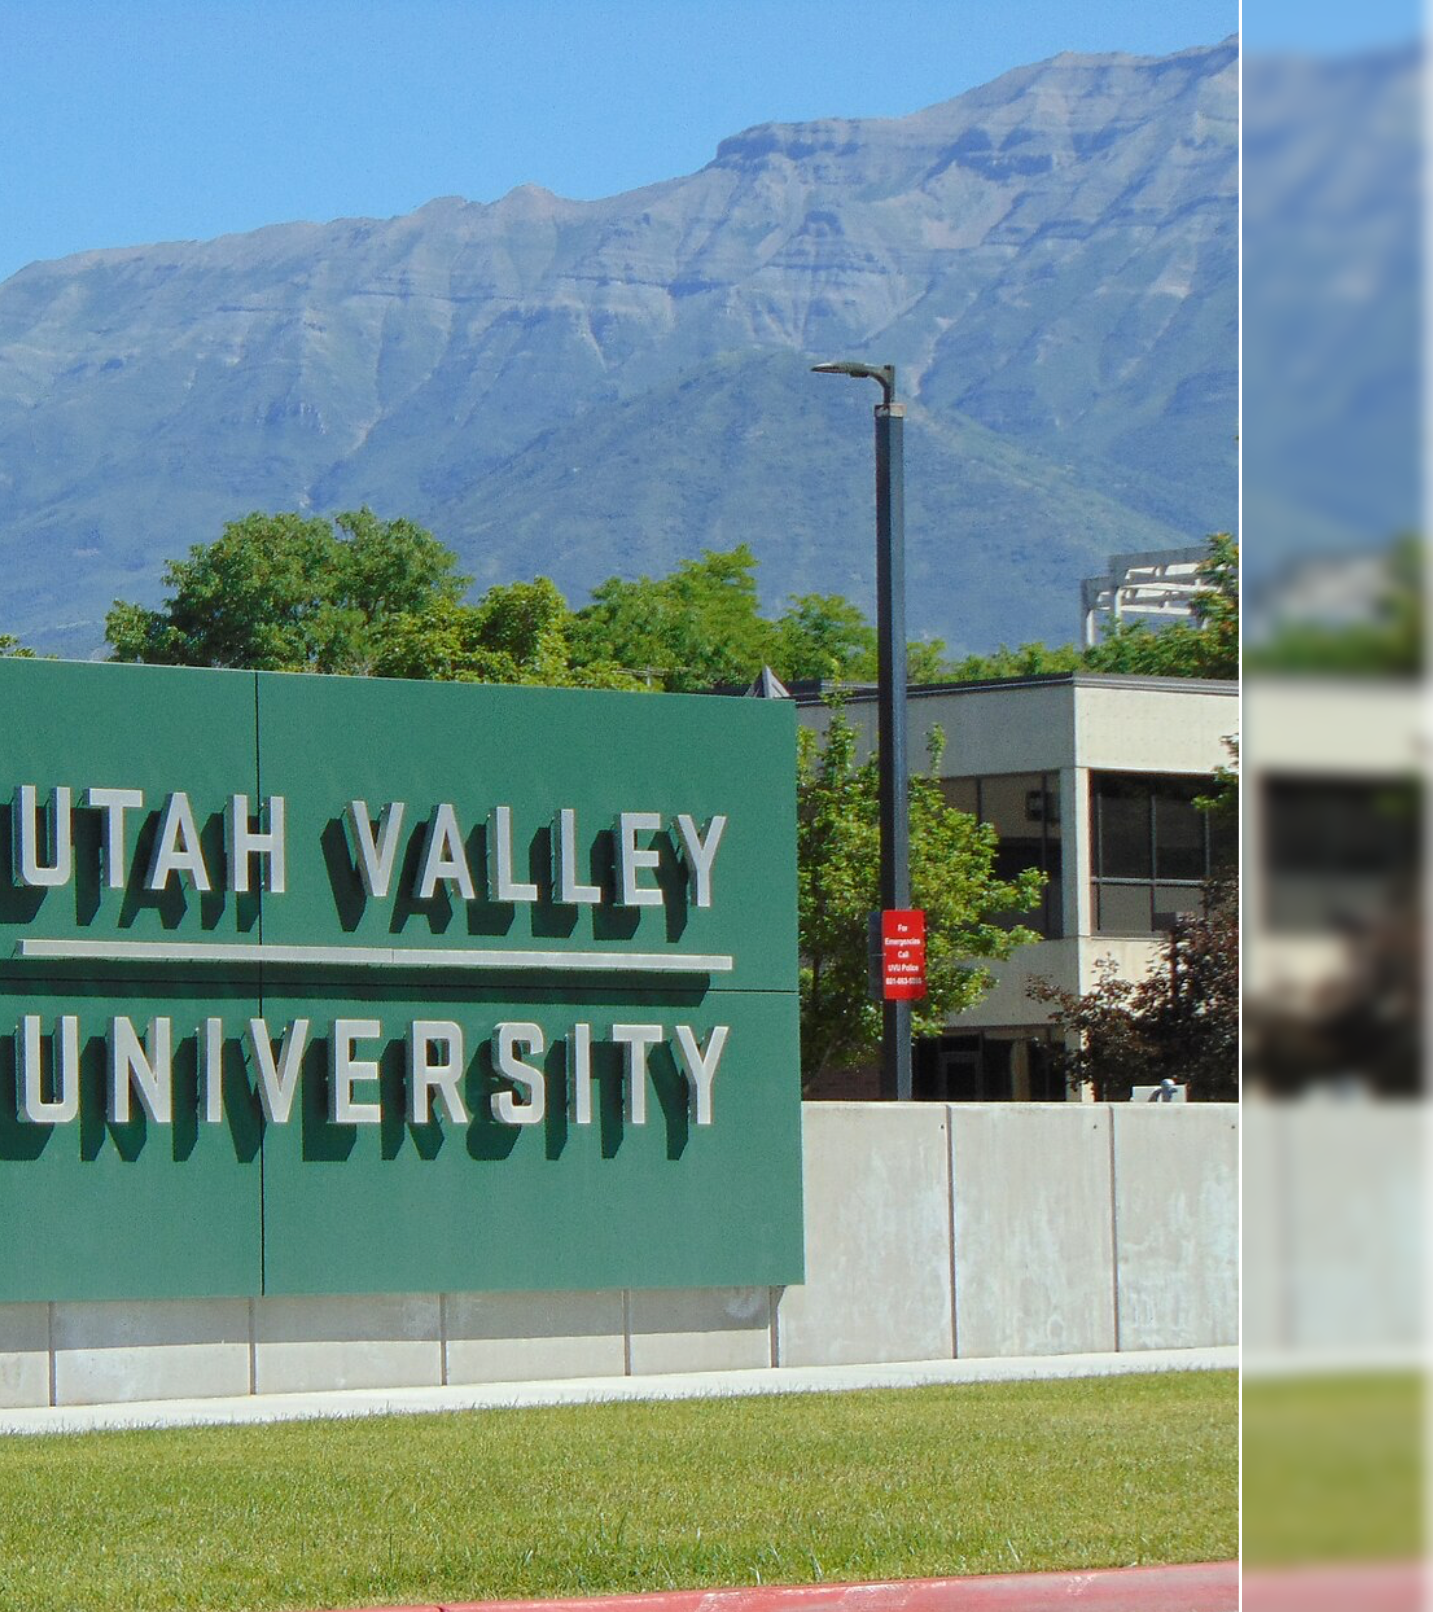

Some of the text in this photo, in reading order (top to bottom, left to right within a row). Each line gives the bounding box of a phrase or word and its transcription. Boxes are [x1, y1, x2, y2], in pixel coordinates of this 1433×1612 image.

[13, 784, 728, 908] UTAH VALLEY
[897, 924, 908, 932] For
[888, 964, 919, 972] UVU Police
[18, 1015, 730, 1126] UNIVERSITY
